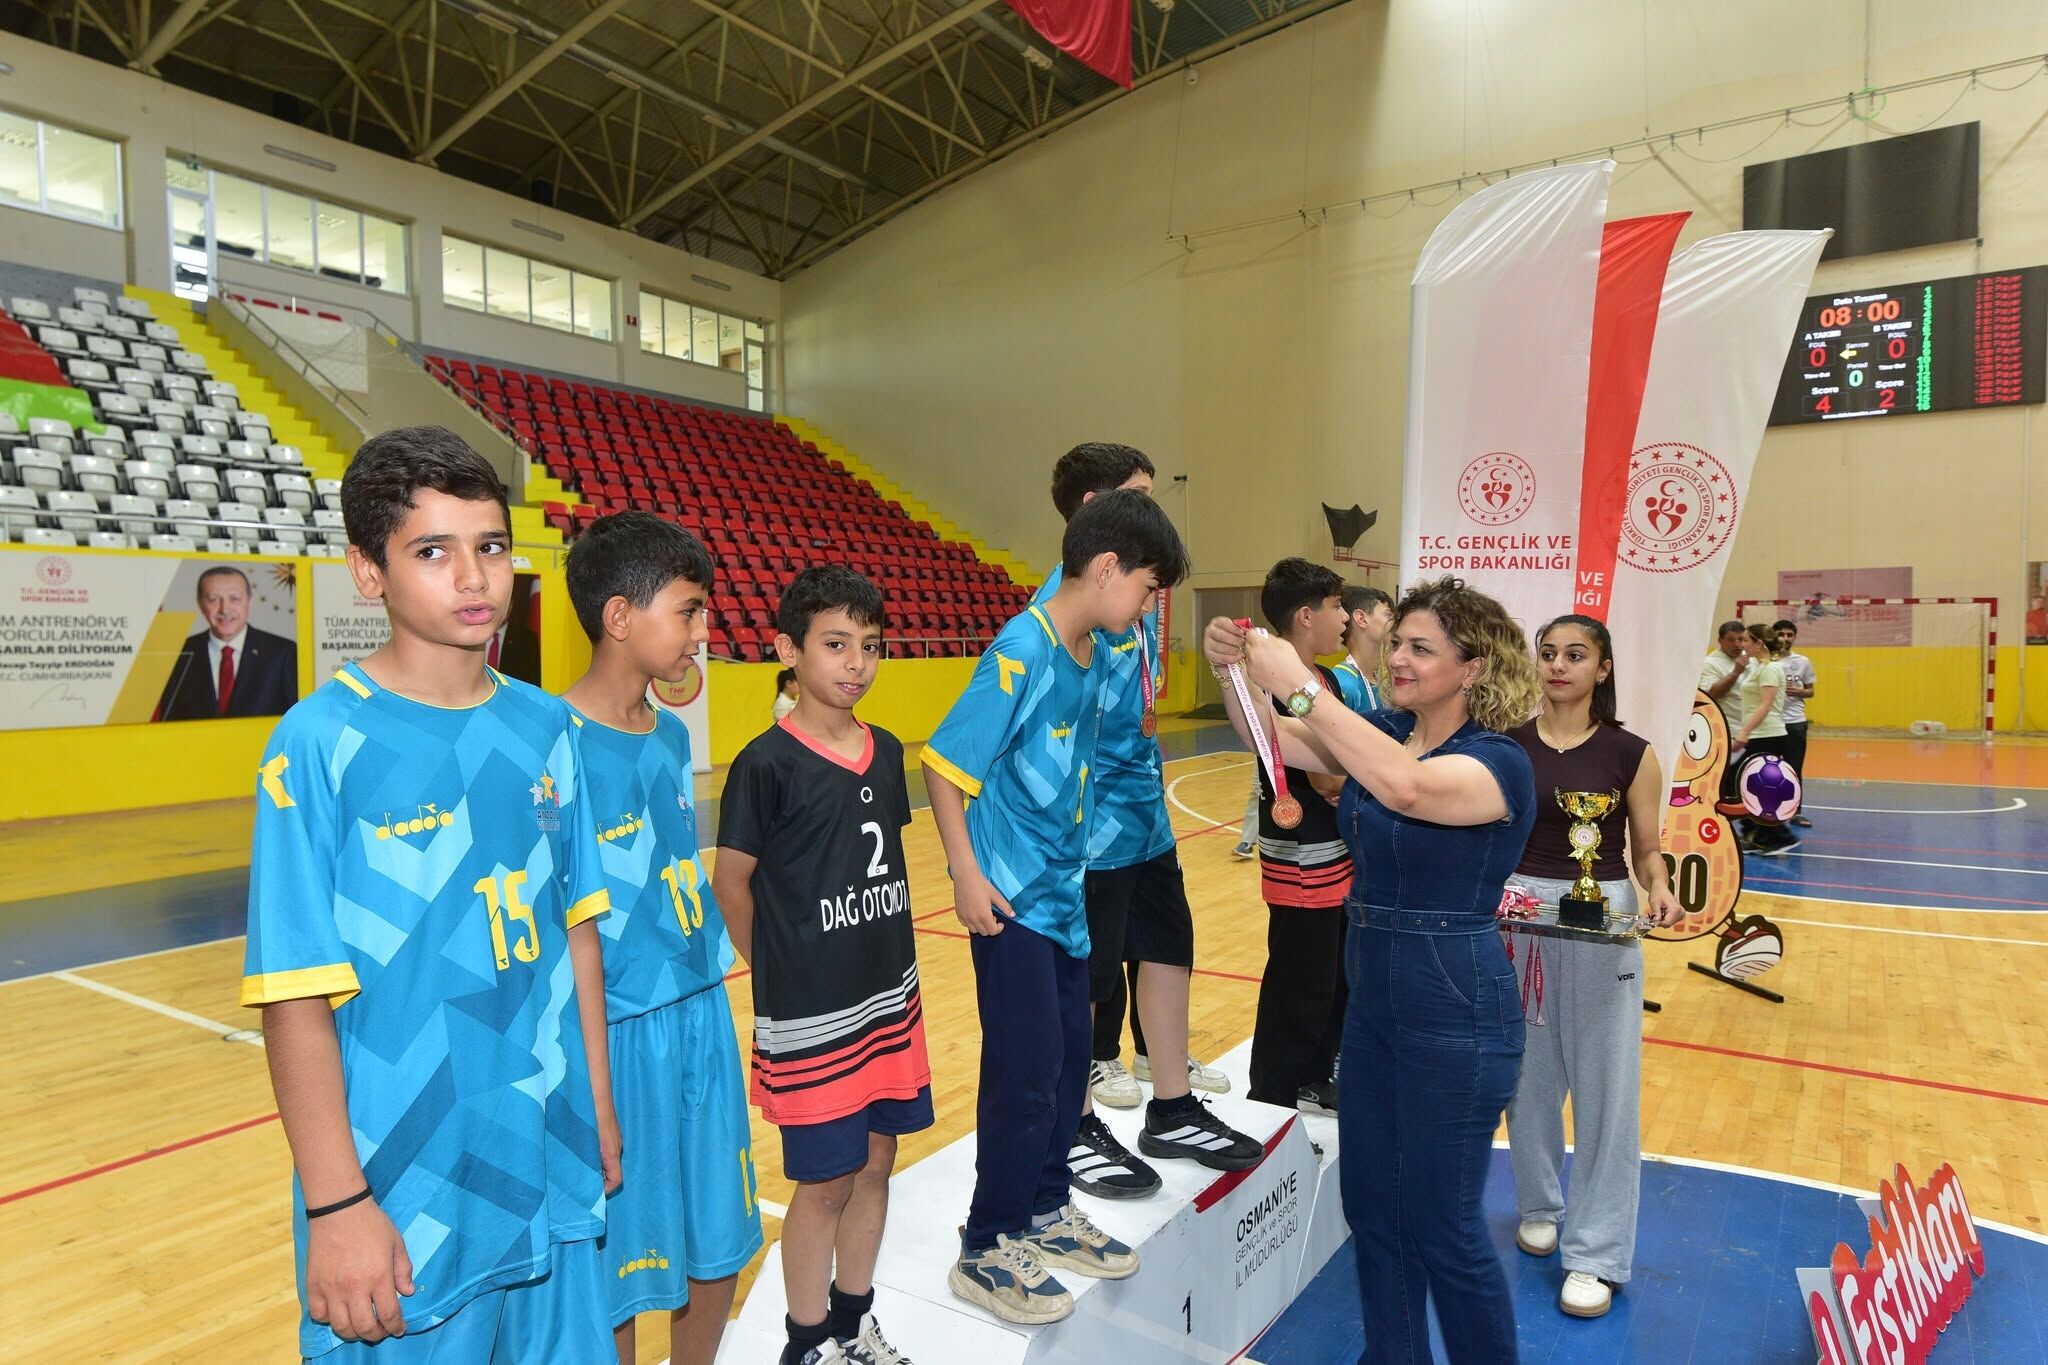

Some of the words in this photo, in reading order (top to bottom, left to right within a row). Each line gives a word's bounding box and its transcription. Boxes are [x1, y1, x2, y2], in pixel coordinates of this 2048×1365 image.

[1820, 300, 1900, 328] 08:00
[1810, 348, 1827, 367] 0
[1888, 338, 1905, 359] 0
[1848, 370, 1863, 387] 0
[1874, 380, 1905, 389] Score
[1811, 386, 1840, 395] Score
[1880, 388, 1895, 409] 2
[1815, 395, 1831, 414] 4
[1697, 482, 1707, 493] VE
[1702, 493, 1711, 517] SPOR
[1419, 536, 1451, 549] T.C.
[1457, 533, 1540, 553] GENÇLİK
[1547, 535, 1571, 549] VE
[1418, 556, 1464, 570] SPOR
[1470, 553, 1570, 570] BAKANLIĞI
[1580, 571, 1604, 587] VE
[20, 613, 107, 628] ANTRENÖR
[109, 616, 129, 628] VE
[352, 617, 391, 628] ANTRE
[58, 643, 133, 654] DİLİYORUM
[322, 642, 376, 652] BAŞARILAR
[375, 803, 454, 842] diadora
[861, 821, 889, 878] 2
[660, 858, 704, 937] 13
[820, 884, 860, 932] DAĞ
[473, 870, 541, 971] 15
[1237, 1170, 1297, 1243] OSMANİYE
[1236, 1225, 1268, 1264] GENÇLİK
[1269, 1218, 1277, 1231] ve
[1278, 1196, 1298, 1222] SPOR
[1245, 1214, 1299, 1281] MÜDÜRLÜĞÜ
[618, 1248, 669, 1279] diadora
[1182, 1289, 1192, 1335] 1
